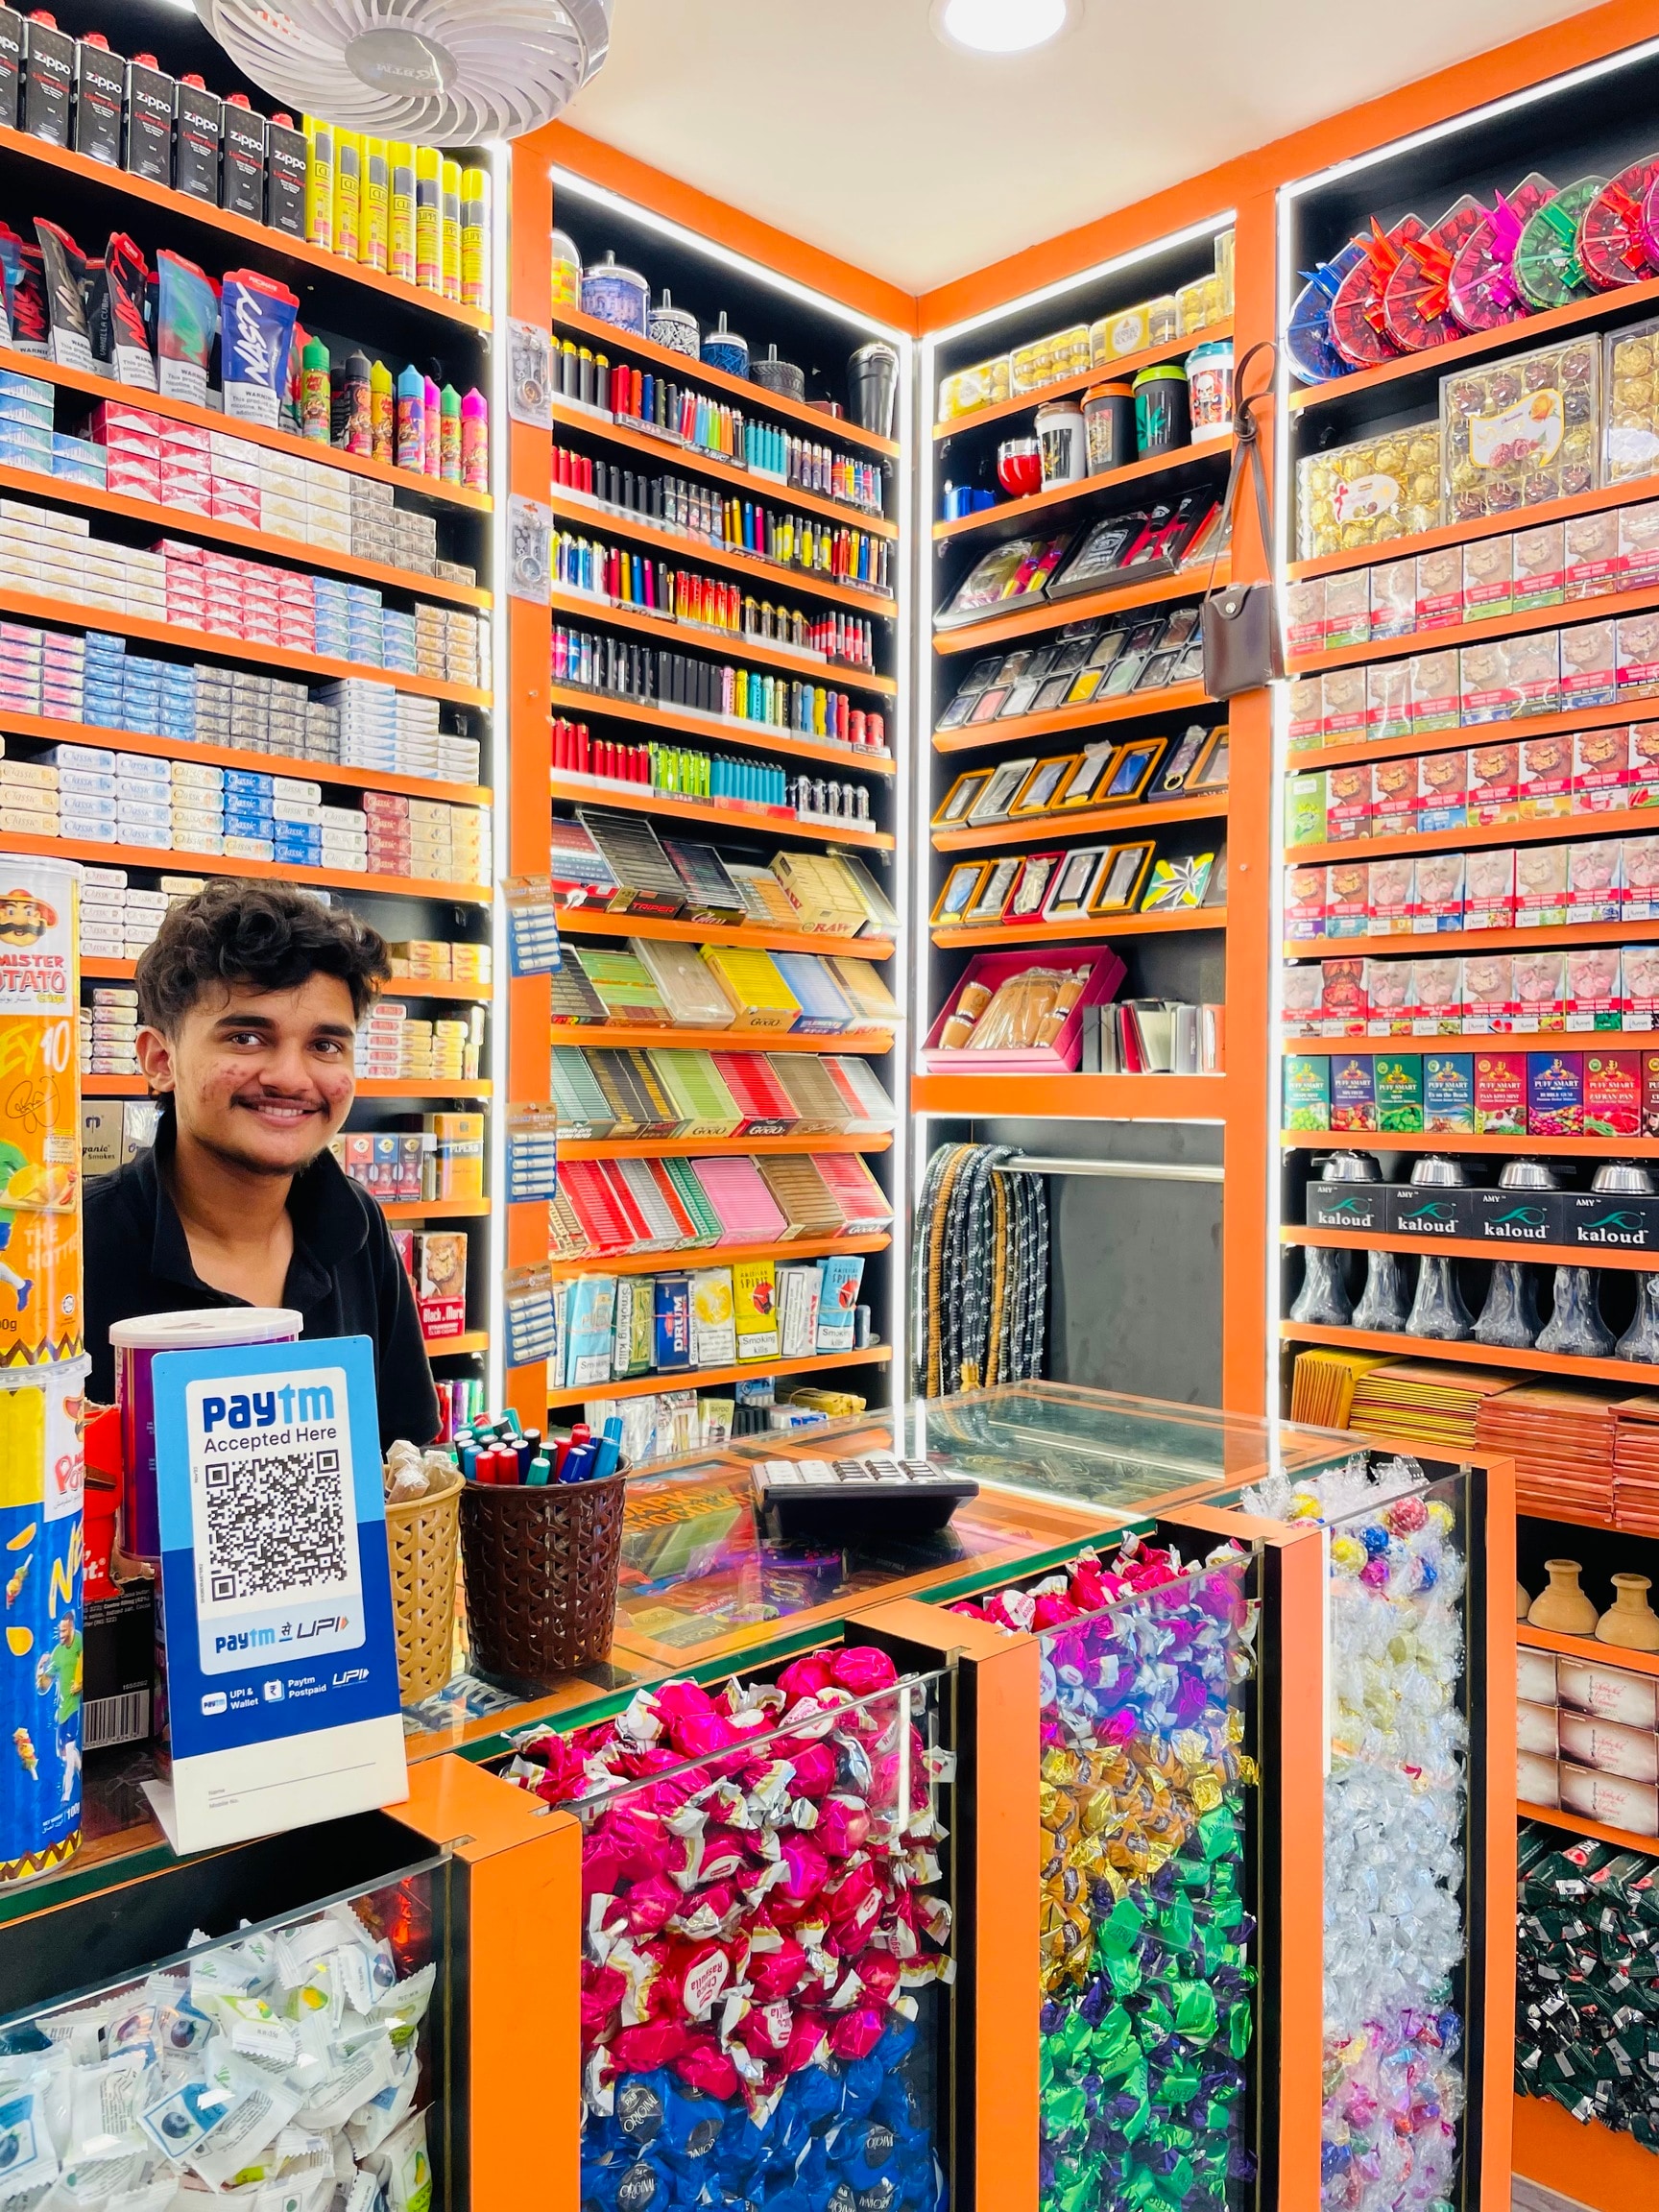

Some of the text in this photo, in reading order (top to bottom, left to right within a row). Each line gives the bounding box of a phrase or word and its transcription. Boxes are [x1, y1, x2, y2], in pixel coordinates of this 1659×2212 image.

[0, 37, 19, 53] ppo
[34, 50, 70, 75] zippo
[85, 71, 122, 94] zippo
[136, 91, 171, 113] zippo
[183, 110, 218, 132] zippo
[230, 131, 263, 152] zippo
[275, 150, 306, 170] zippo
[233, 281, 270, 385] NASTY
[62, 750, 93, 764] Classic
[63, 774, 94, 788] Classic
[228, 775, 256, 787] Classic
[64, 798, 95, 811] Classic
[228, 797, 257, 809] Classic
[64, 821, 96, 834] Classic
[228, 819, 257, 831] Classic
[278, 848, 305, 859] Classic
[813, 923, 853, 934] RAW
[0, 971, 66, 993] TATO
[1318, 1212, 1372, 1227] kaloud
[1398, 1217, 1455, 1234] kaloud
[1484, 1222, 1547, 1239] kaloud
[1577, 1227, 1646, 1244] kaloud
[617, 1287, 631, 1367] Smoking kills
[674, 1296, 685, 1353] DRUM
[742, 1335, 776, 1346] Smoking
[754, 1345, 769, 1354] kills
[204, 1428, 337, 1454] Accepted Here
[297, 1616, 342, 1639] UPI
[288, 1676, 316, 1689] Paytm
[332, 1669, 364, 1686] UPI
[229, 1687, 253, 1699] UPI &
[289, 1684, 327, 1698] Postpaid
[230, 1697, 259, 1710] Wallet
[691, 1961, 723, 1990] Rasgulla
[696, 1976, 717, 1998] Choco
